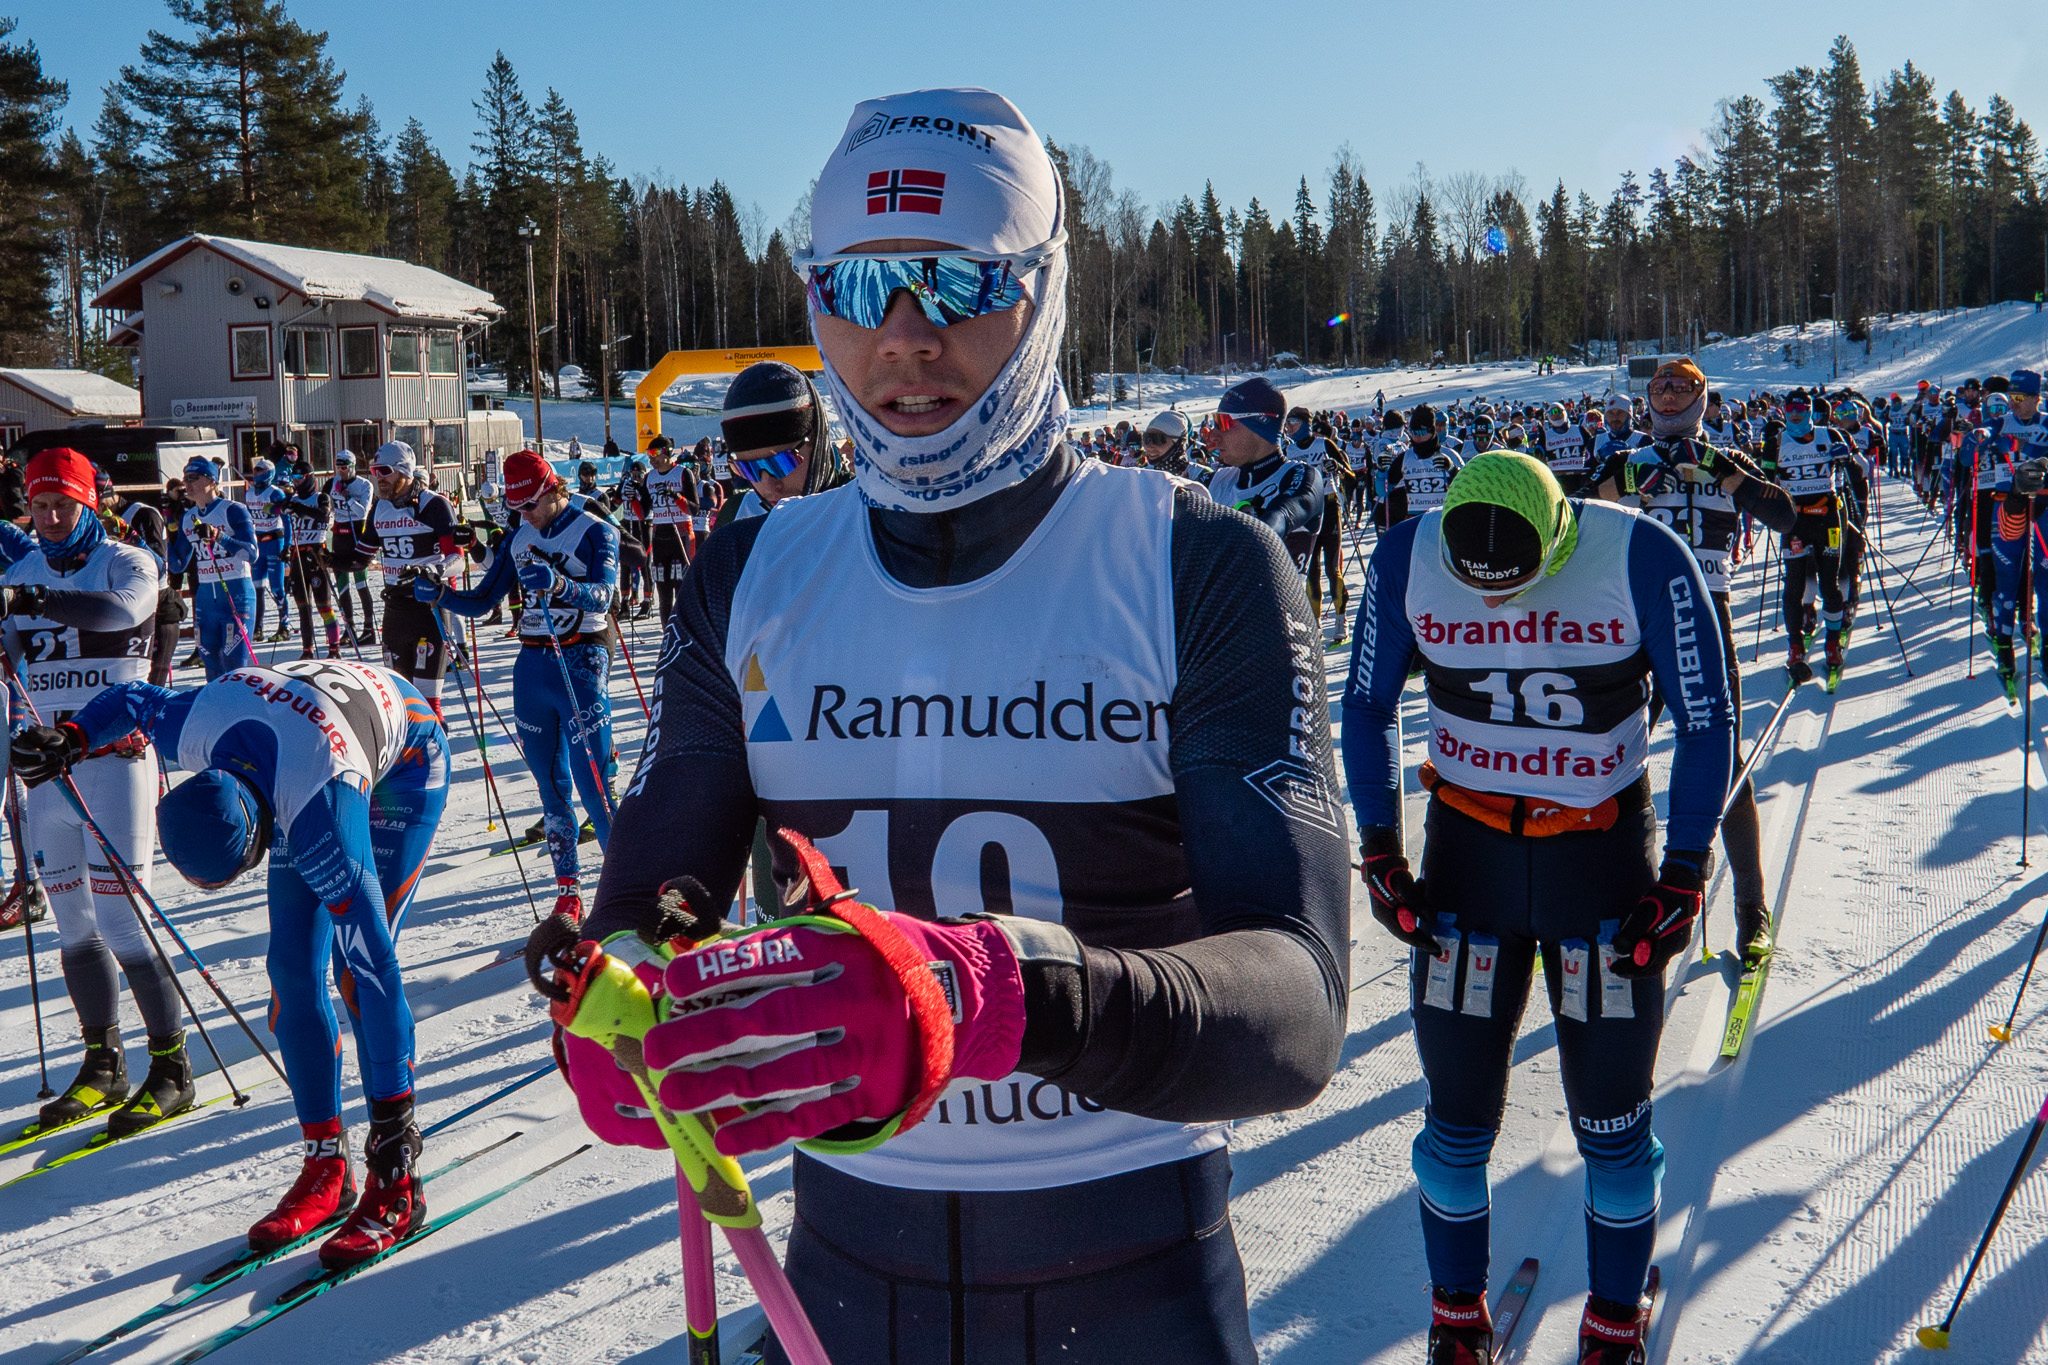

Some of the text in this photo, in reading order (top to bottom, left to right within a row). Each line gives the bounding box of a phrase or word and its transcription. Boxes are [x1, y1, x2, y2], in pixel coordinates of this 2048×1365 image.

[888, 115, 996, 149] FRONT
[734, 352, 775, 360] Ramudden
[1552, 445, 1581, 460] 144
[1786, 462, 1831, 481] 354
[1408, 478, 1445, 493] 362
[383, 536, 415, 559] 56
[1460, 558, 1489, 571] TEAM
[1468, 565, 1520, 580] HEDBYS
[1414, 610, 1626, 645] brandfast
[31, 626, 82, 662] 21
[126, 635, 152, 658] 21
[1468, 671, 1585, 727] 16
[219, 671, 348, 760] brandfast
[388, 820, 407, 829] AB
[812, 809, 1064, 925] 10
[1371, 873, 1394, 901] MADSHUS
[1658, 906, 1682, 931] MADSHUS
[697, 935, 804, 981] HESTRA
[1725, 1016, 1743, 1048] FISCHER
[310, 1167, 331, 1195] REDLINE
[1432, 1304, 1480, 1320] MADSHUS
[1584, 1316, 1636, 1337] MADSHUS
